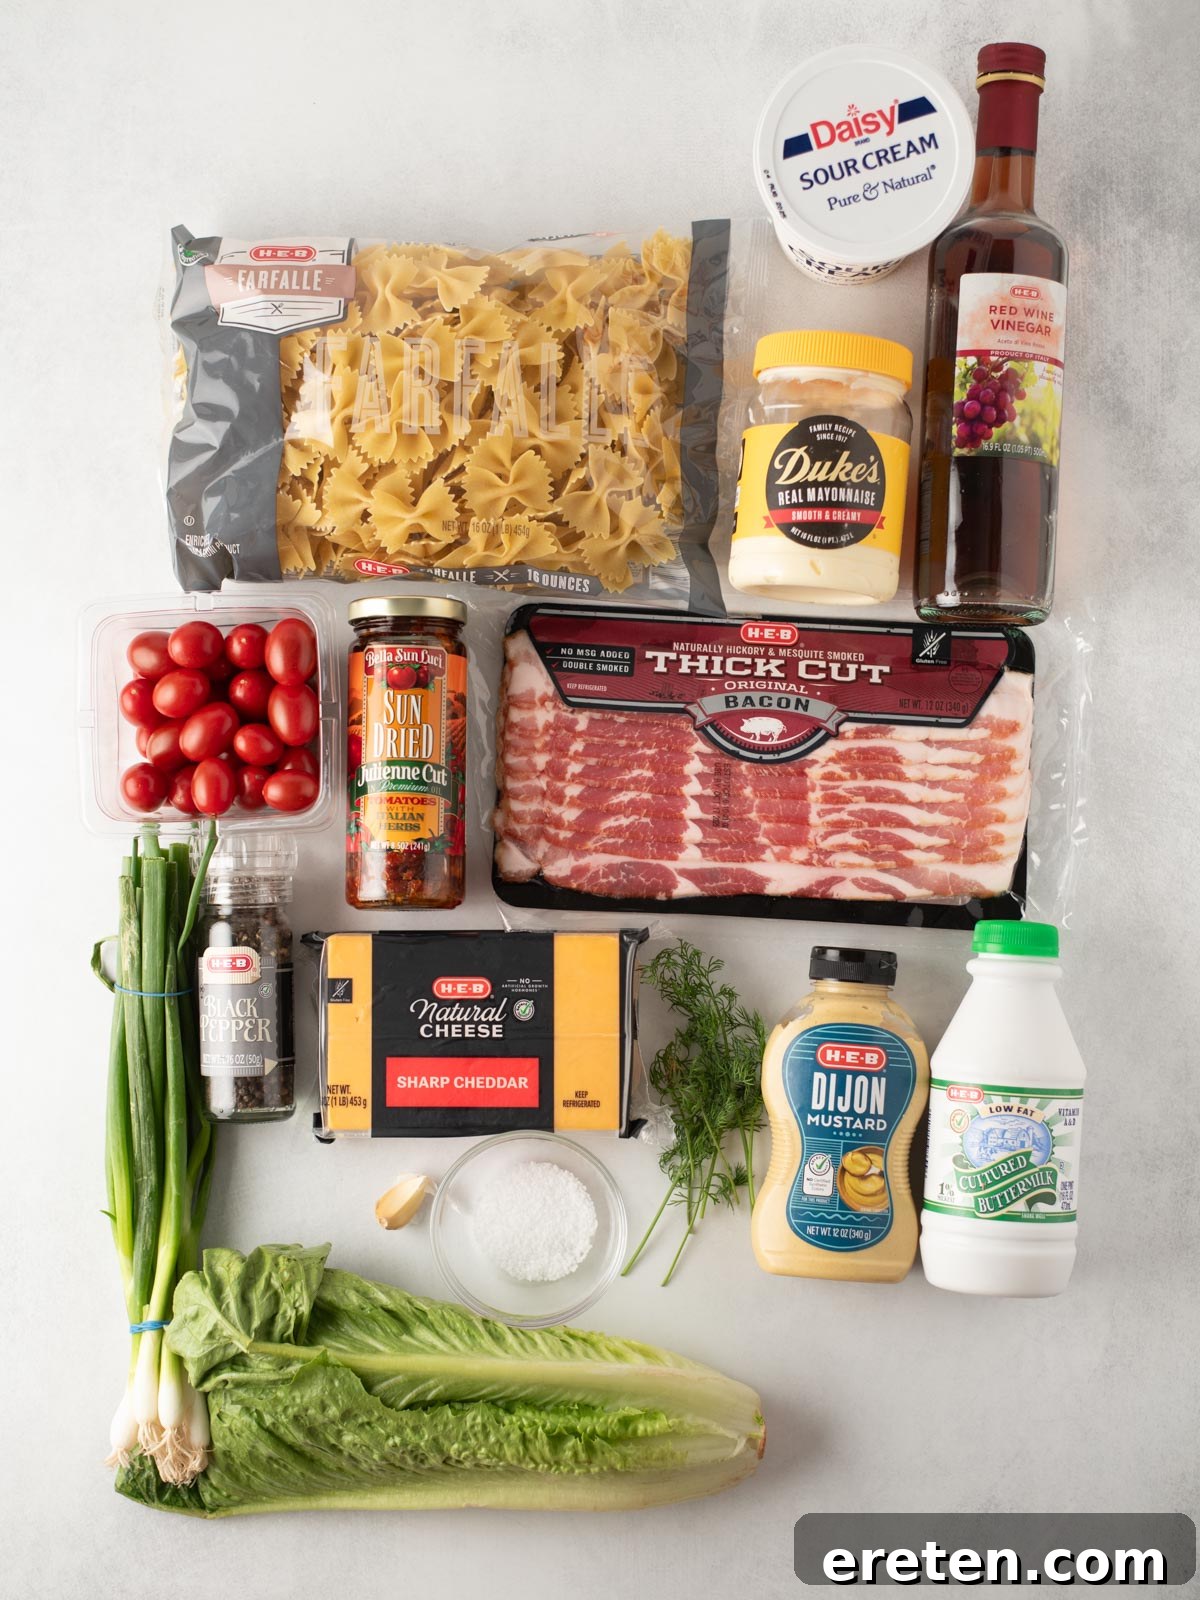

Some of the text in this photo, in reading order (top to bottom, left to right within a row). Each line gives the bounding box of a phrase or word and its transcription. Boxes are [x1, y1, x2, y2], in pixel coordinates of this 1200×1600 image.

[810, 103, 897, 150] Daisy
[799, 133, 939, 190] SOUR CREAM
[827, 193, 861, 211] Pure
[862, 182, 880, 201] &
[237, 269, 323, 293] FARFALLE
[989, 305, 1054, 323] RED WINE
[990, 319, 1052, 337] VINEGAR
[1034, 354, 1050, 362] ITALY
[809, 423, 857, 438] FAMILY RECIPE
[816, 433, 834, 441] SINCE
[994, 442, 1002, 452] FL
[1002, 443, 1011, 453] OZ
[774, 445, 880, 485] Duke's
[778, 487, 876, 506] REAL MAYONNAISE
[791, 510, 862, 522] SMOOTH & CREAMY
[442, 520, 455, 532] NET
[471, 522, 480, 533] 16
[482, 522, 492, 533] OZ
[513, 523, 530, 539] 454g
[790, 526, 801, 536] NET
[814, 535, 821, 544] OZ
[527, 568, 590, 593] 16 OUNCES
[365, 648, 443, 668] Bella Sun Luci
[560, 647, 631, 659] NO MSG ADDED
[672, 642, 865, 662] NATURALLY HICKORY & MESQUITE SMOKED
[915, 657, 935, 665] Gluten
[562, 661, 630, 673] DOUBLE SMOKED
[645, 651, 891, 684] THICK CUT
[578, 684, 608, 692] REFRIGERATED
[724, 680, 809, 695] ORIGINAL
[383, 689, 422, 725] SUN
[724, 695, 810, 713] BACON
[899, 698, 910, 709] NET
[926, 700, 934, 711] 12
[935, 701, 944, 711] OZ
[373, 721, 434, 759] DRIED
[357, 761, 448, 787] Julienne Cut
[380, 780, 429, 792] Premium
[204, 995, 259, 1019] BLACK
[409, 997, 508, 1023] Natural
[200, 1015, 273, 1043] PEPPER
[419, 1024, 504, 1038] CHEESE
[234, 1054, 245, 1064] OZ
[327, 1085, 351, 1095] NET WT.
[397, 1076, 529, 1089] SHARP CHEDDAR
[338, 1097, 349, 1107] LB)
[350, 1096, 362, 1106] 453
[811, 1071, 886, 1115] DIJON
[563, 1100, 600, 1108] REFRIGERATED
[989, 1105, 1036, 1117] LOW FAT
[807, 1113, 887, 1131] MUSTARD
[978, 1171, 1054, 1213] BUTTERMILK
[807, 1225, 819, 1235] NET
[832, 1228, 839, 1237] 12
[840, 1229, 848, 1238] OZ
[849, 1229, 863, 1239] (340
